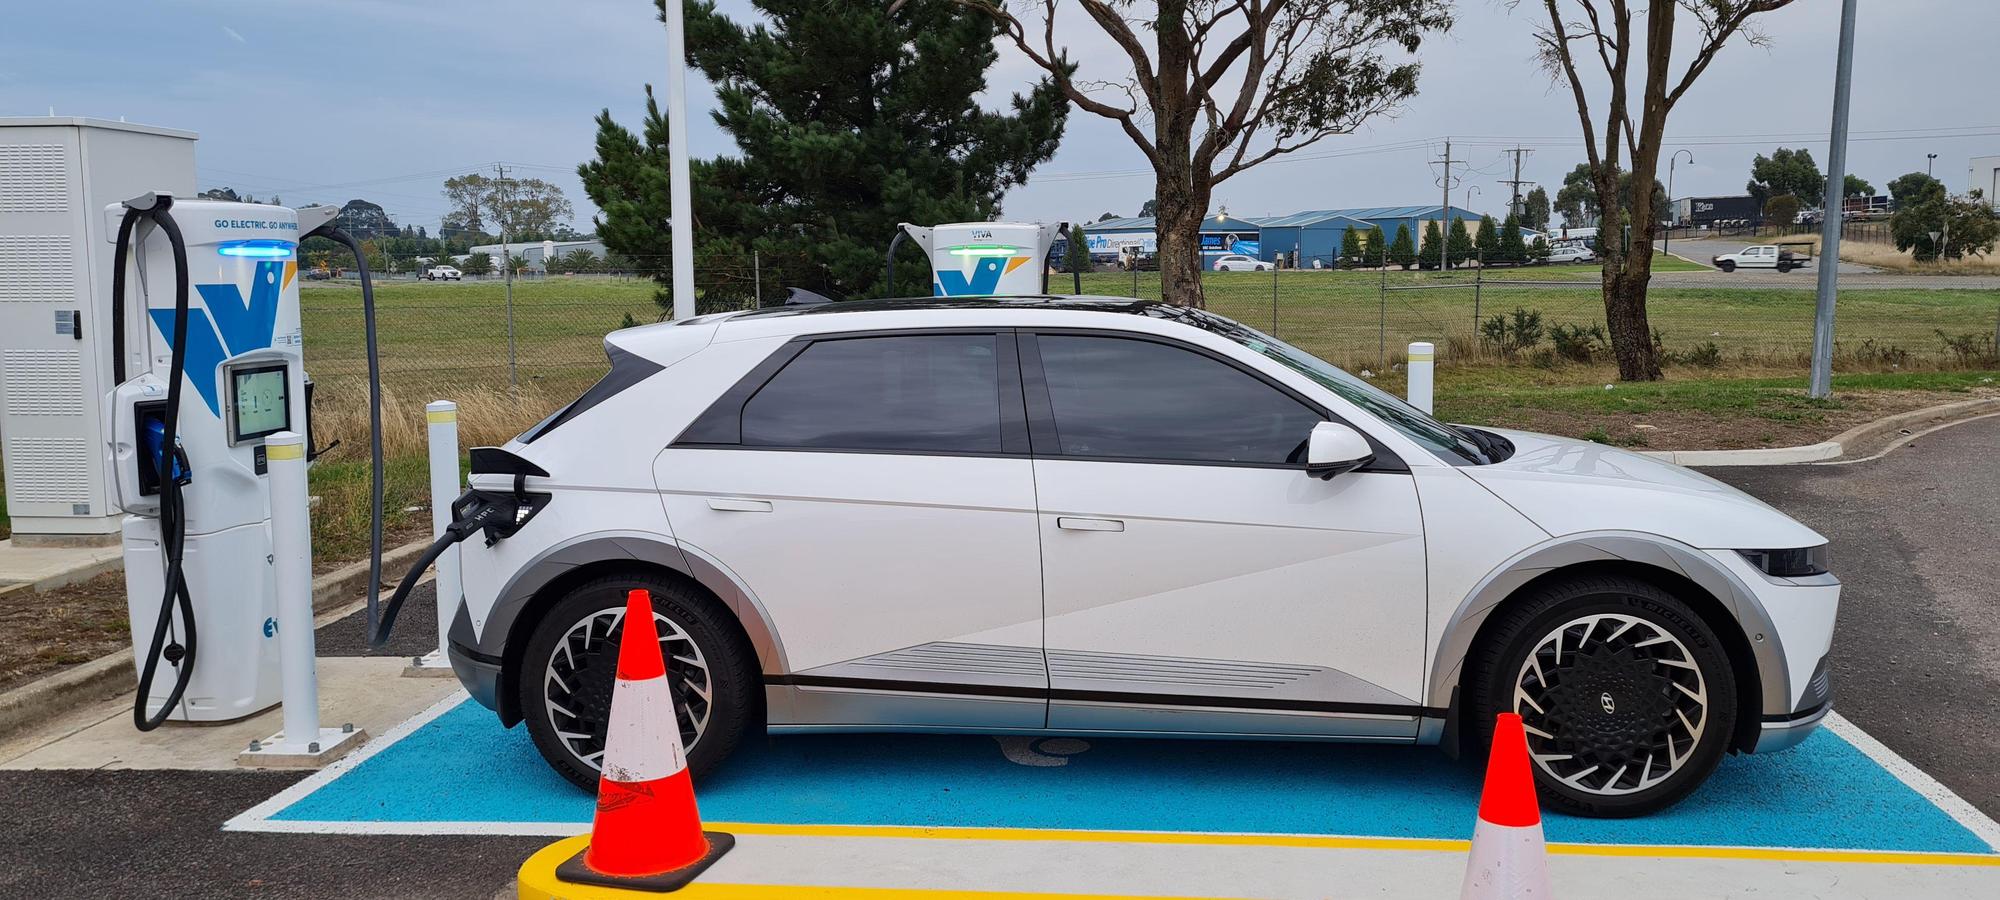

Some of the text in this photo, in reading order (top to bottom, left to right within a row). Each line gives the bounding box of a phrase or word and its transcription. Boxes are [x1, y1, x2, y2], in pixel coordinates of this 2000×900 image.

[214, 220, 228, 228] GO
[230, 220, 268, 229] ELECTRIC.
[269, 221, 277, 230] GO
[474, 507, 495, 521] HPC
[650, 595, 698, 625] CHELIN
[1643, 601, 1710, 649] MICHELIN
